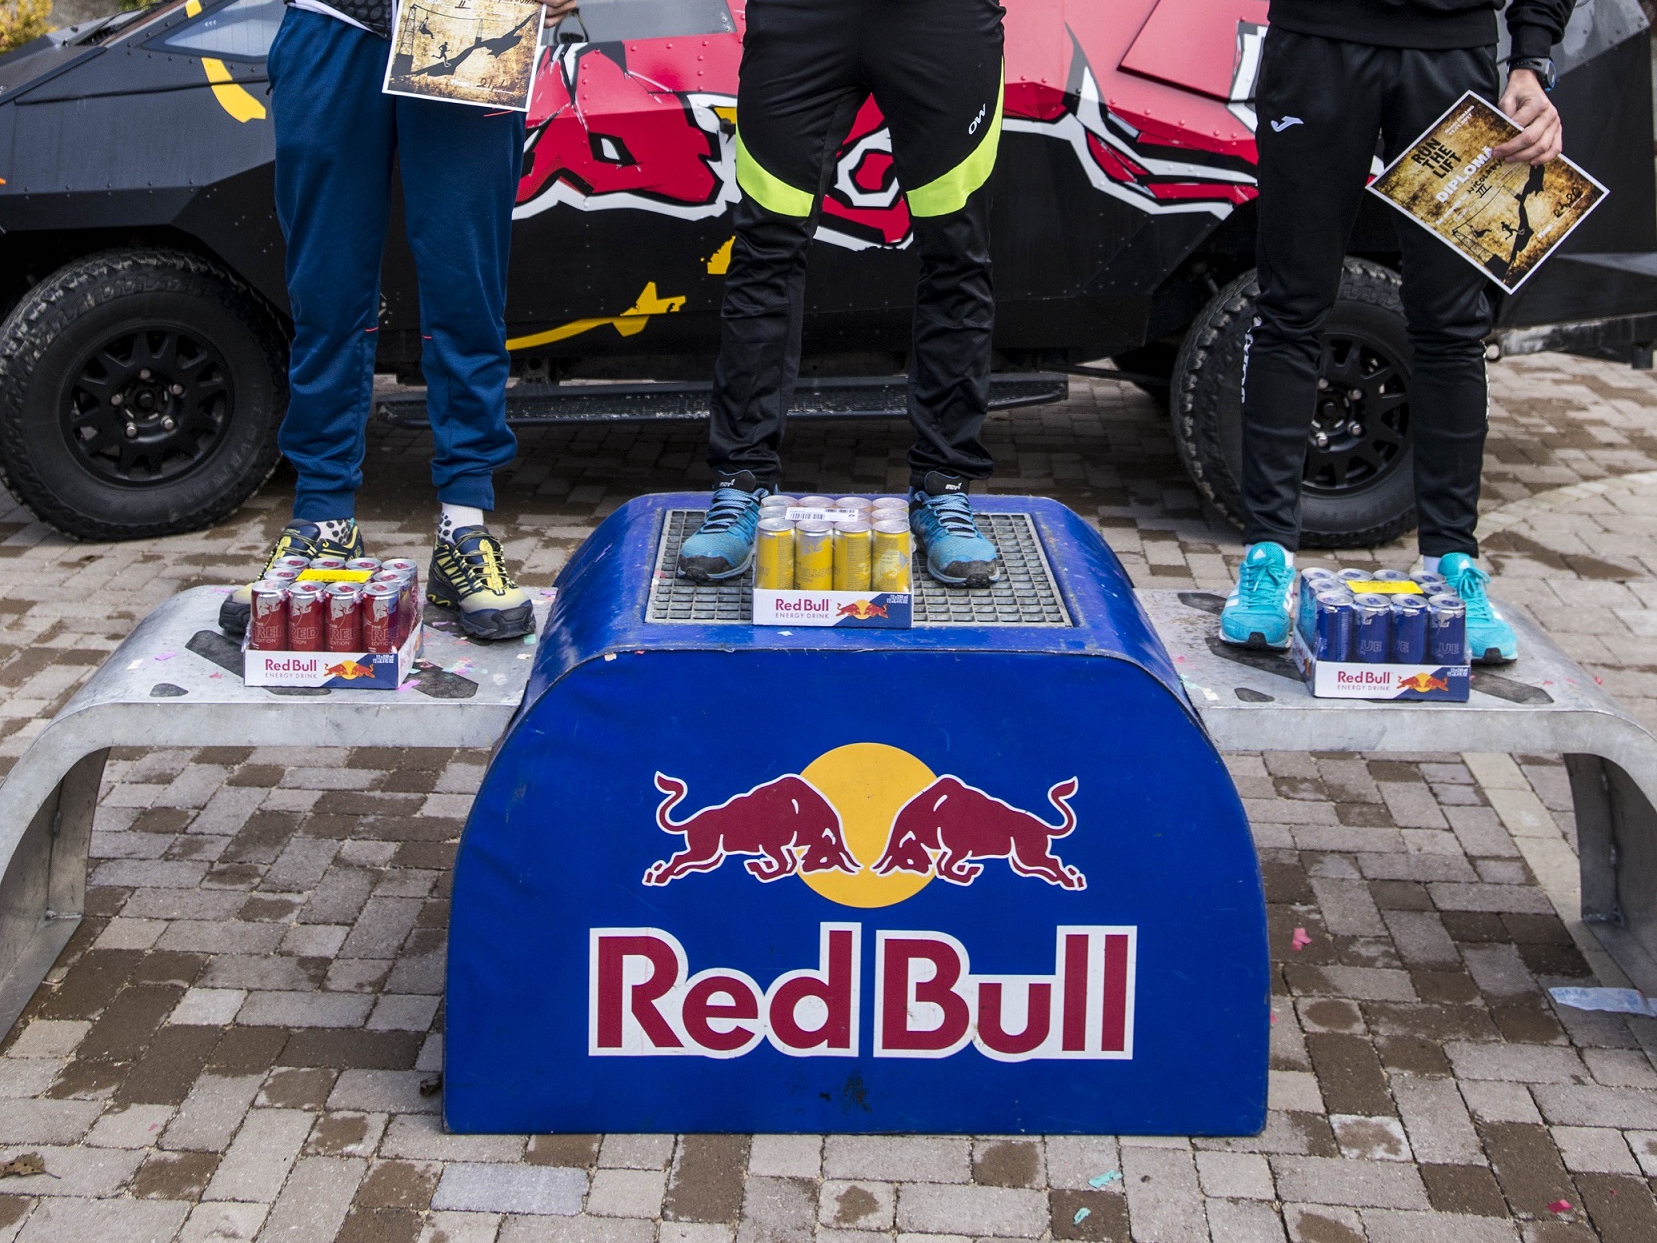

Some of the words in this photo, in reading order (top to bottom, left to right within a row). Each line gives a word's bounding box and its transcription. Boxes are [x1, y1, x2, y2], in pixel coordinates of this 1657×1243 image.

[1410, 138, 1442, 165] RUN
[1422, 144, 1451, 171] THE
[1432, 150, 1462, 180] LIFT
[776, 598, 800, 611] Red
[804, 598, 829, 612] Bull
[264, 658, 289, 672] Red
[290, 658, 317, 672] Bull
[1338, 670, 1363, 684] Red
[1365, 672, 1390, 684] Bull
[590, 923, 861, 1058] Red
[874, 926, 1137, 1061] Bull
